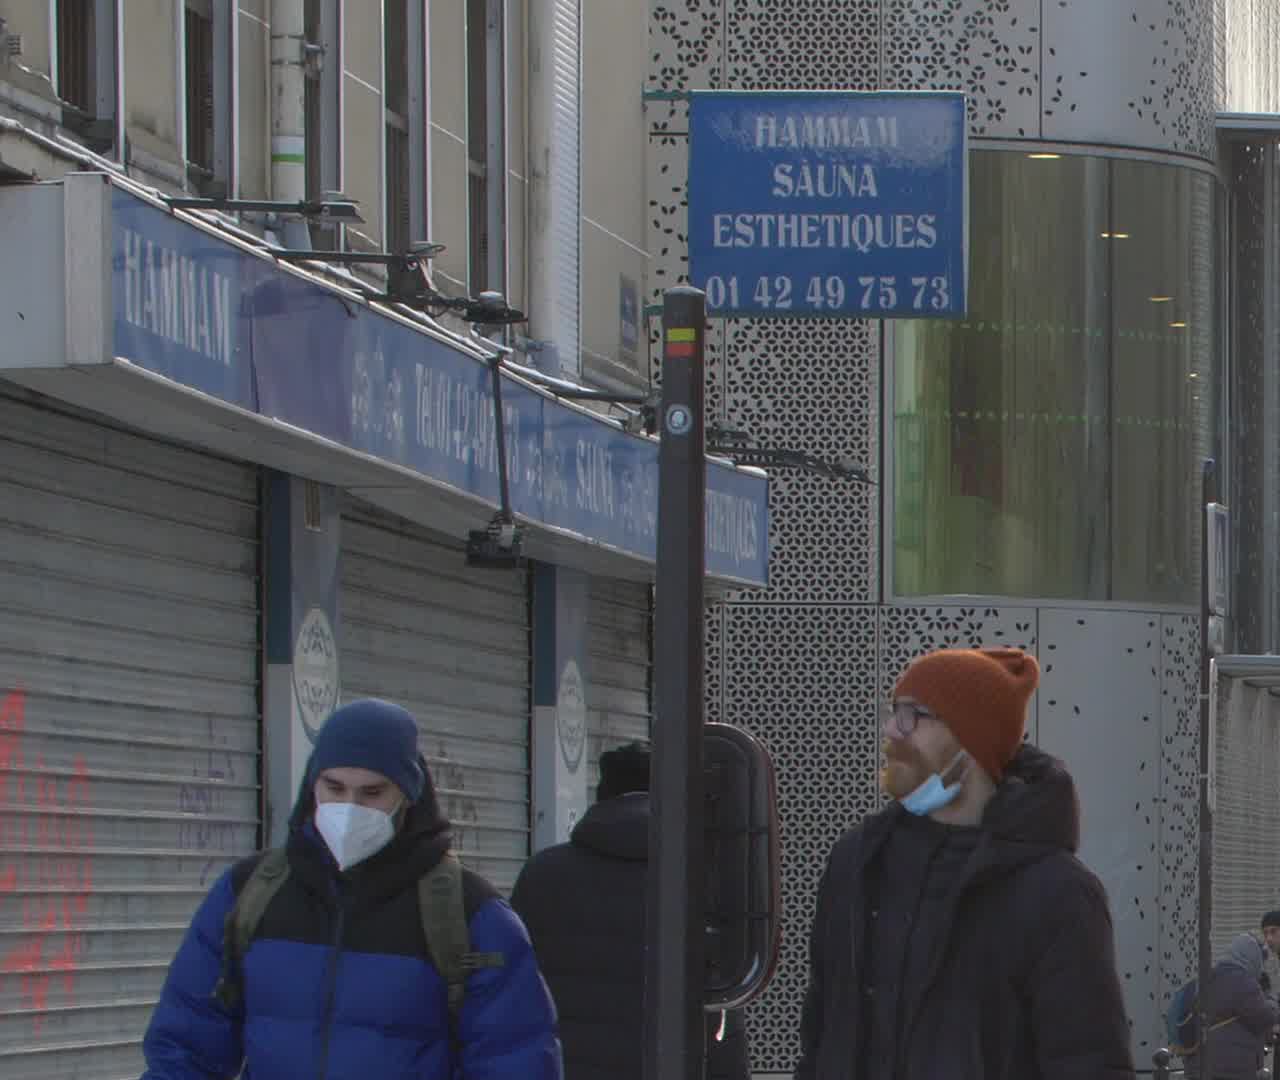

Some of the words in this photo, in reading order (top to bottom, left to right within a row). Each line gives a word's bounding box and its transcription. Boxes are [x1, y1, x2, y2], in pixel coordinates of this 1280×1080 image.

[754, 116, 899, 149] HAMMAM
[772, 163, 878, 198] SAUNA
[712, 213, 937, 254] ESTHETIQUES
[123, 229, 232, 369] HAMMAM
[705, 275, 740, 309] 01
[753, 275, 793, 309] 42
[805, 275, 845, 309] 49
[859, 275, 898, 309] 75
[911, 275, 950, 309] 73
